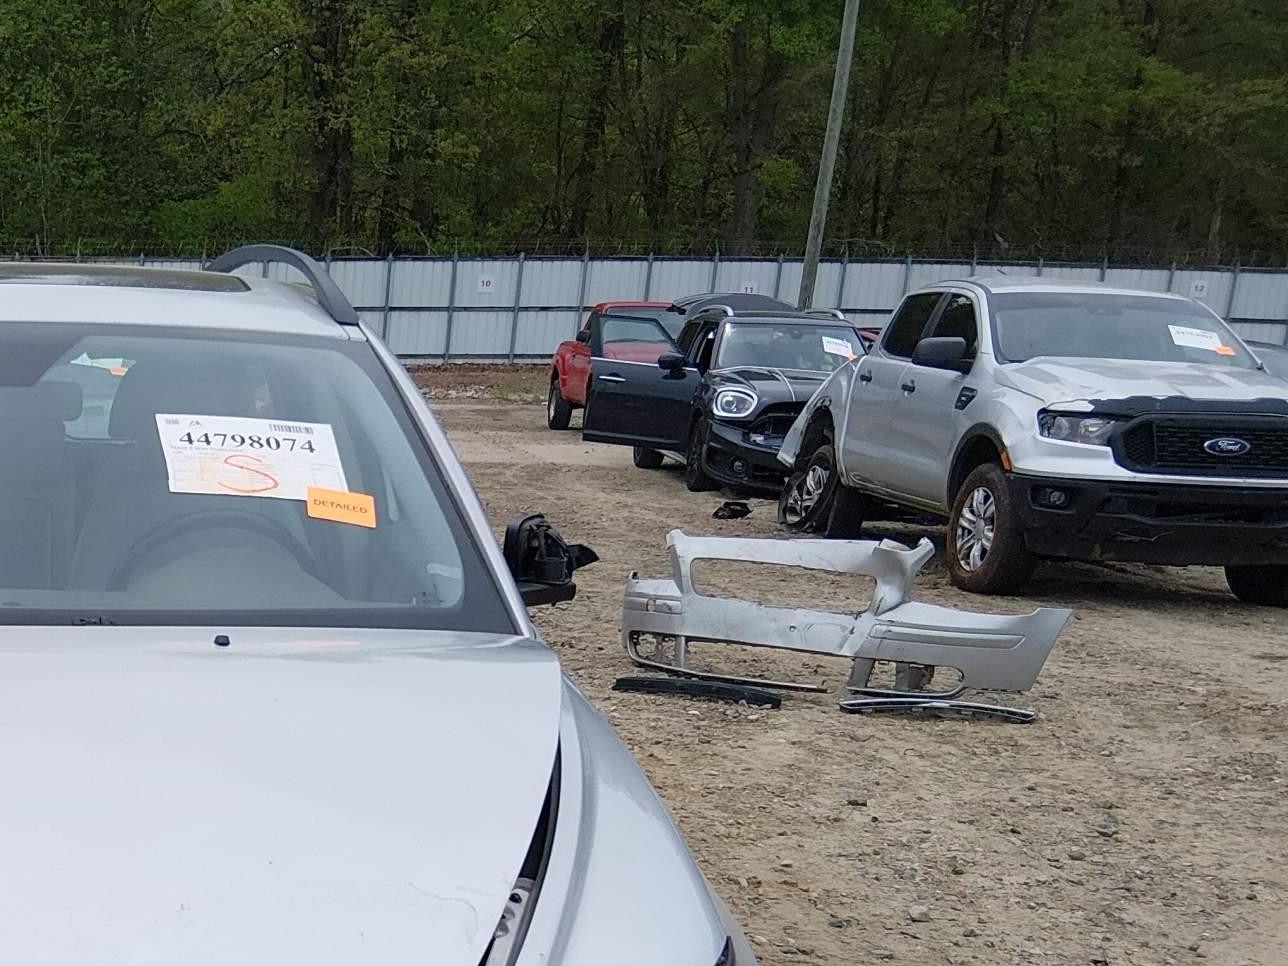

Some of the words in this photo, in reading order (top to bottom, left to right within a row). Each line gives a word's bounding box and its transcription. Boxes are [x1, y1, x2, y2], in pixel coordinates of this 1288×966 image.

[481, 280, 492, 288] 10
[1194, 284, 1205, 292] 12
[744, 286, 754, 294] 11
[179, 431, 316, 454] 44798074
[1216, 440, 1242, 452] Ford
[313, 498, 368, 514] DETAILED
